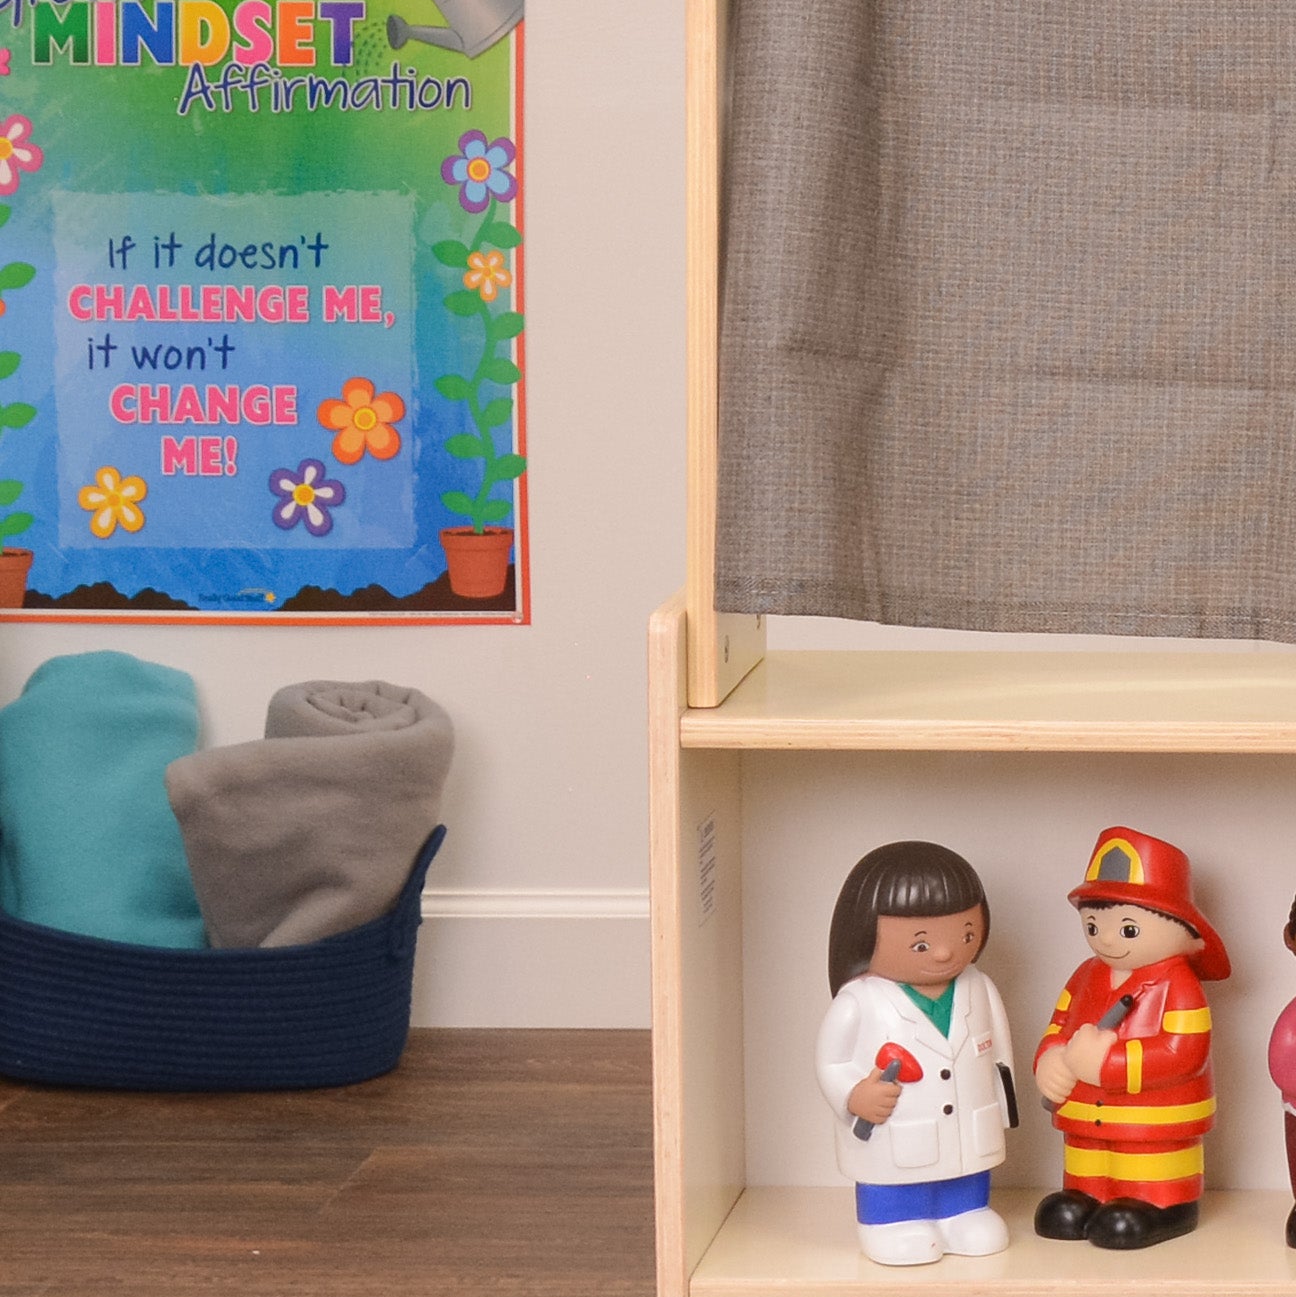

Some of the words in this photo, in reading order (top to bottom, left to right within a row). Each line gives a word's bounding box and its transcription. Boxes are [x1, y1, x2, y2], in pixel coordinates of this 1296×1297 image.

[32, 0, 366, 66] MINDSET
[177, 61, 472, 116] Affirmation
[108, 235, 136, 270] If
[153, 232, 182, 270] it
[195, 232, 329, 270] doesn't
[67, 284, 309, 323] CHALLENGE
[322, 284, 396, 328] ME,
[87, 335, 117, 370] it
[132, 333, 235, 371] won't
[108, 384, 298, 426] CHANGE
[161, 436, 238, 476] ME!
